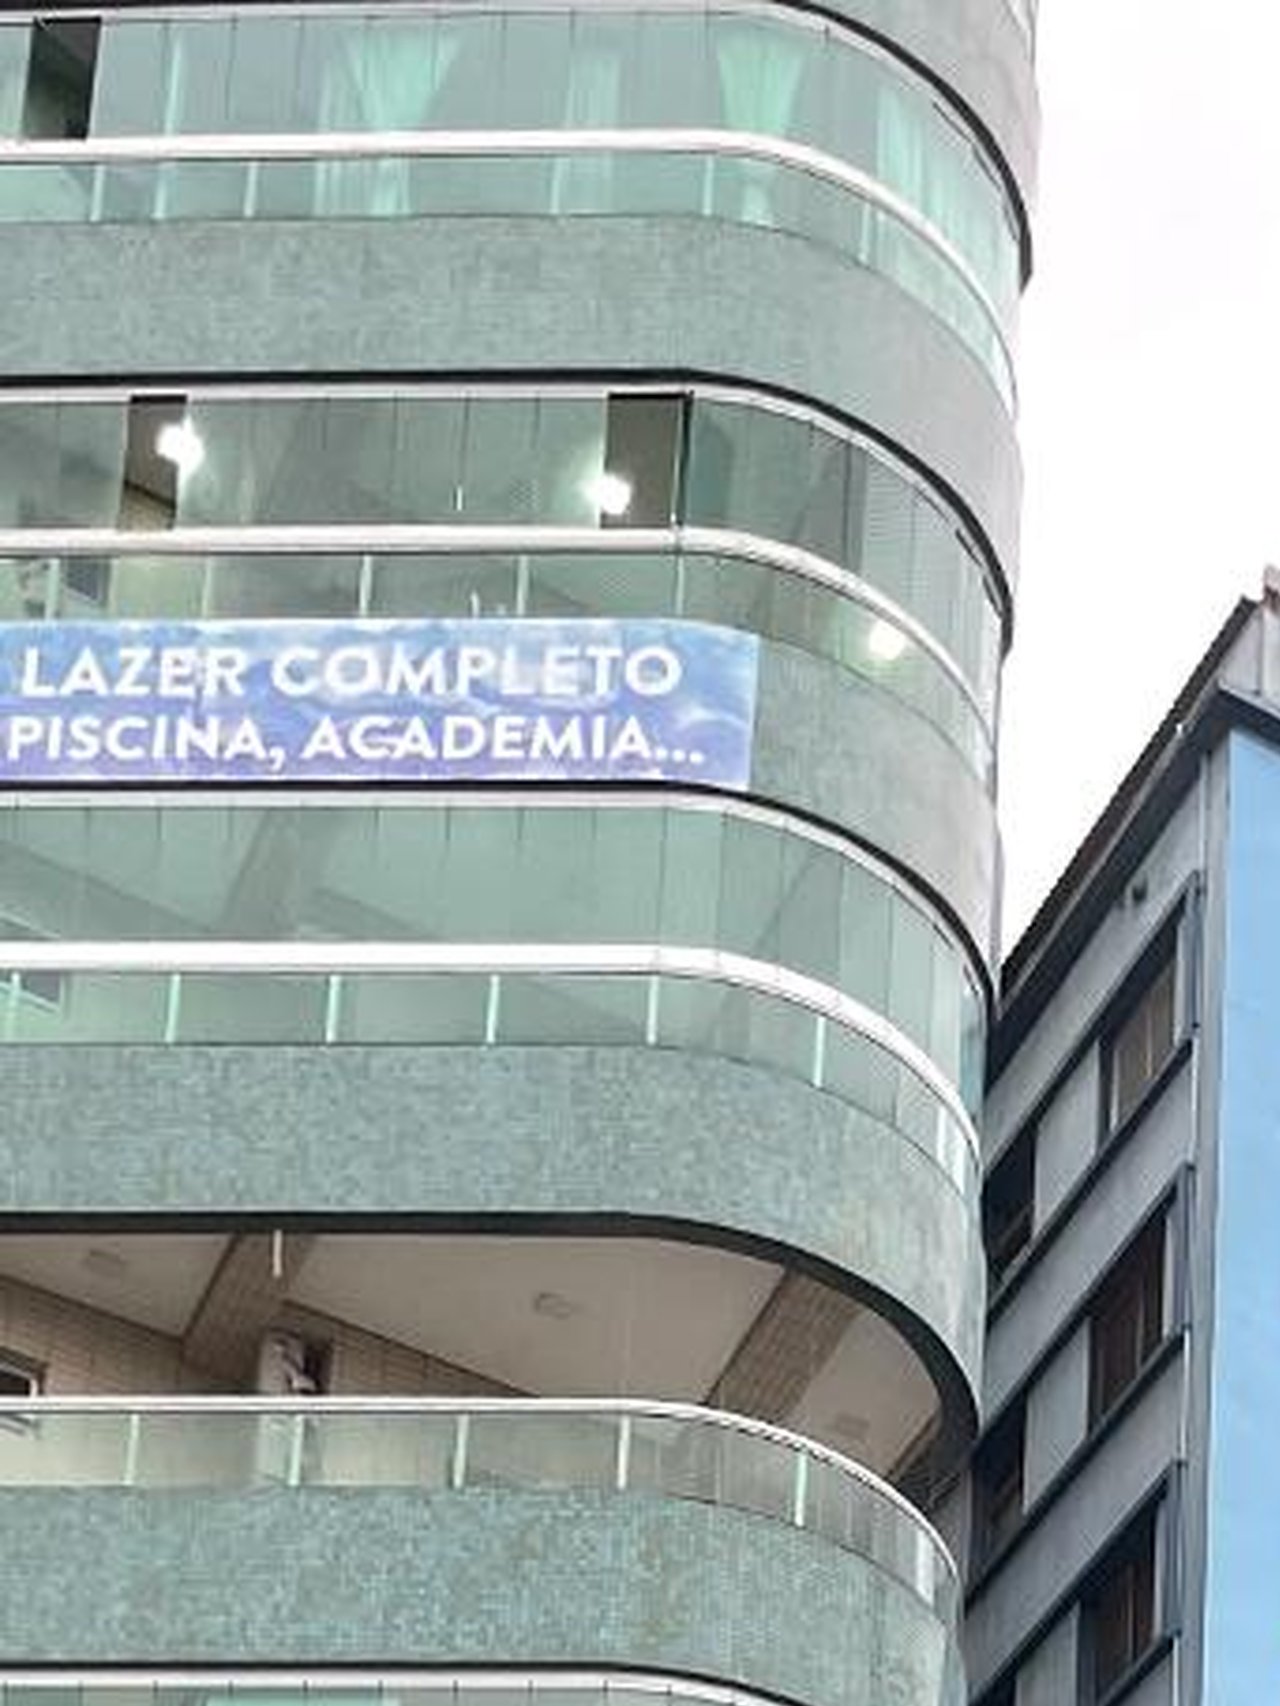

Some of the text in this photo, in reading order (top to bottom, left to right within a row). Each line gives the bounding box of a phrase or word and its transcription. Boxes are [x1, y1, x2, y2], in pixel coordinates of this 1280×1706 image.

[20, 645, 682, 698] LAZER COMPLETO
[6, 716, 706, 769] PISCINA, ACADEMIA...
